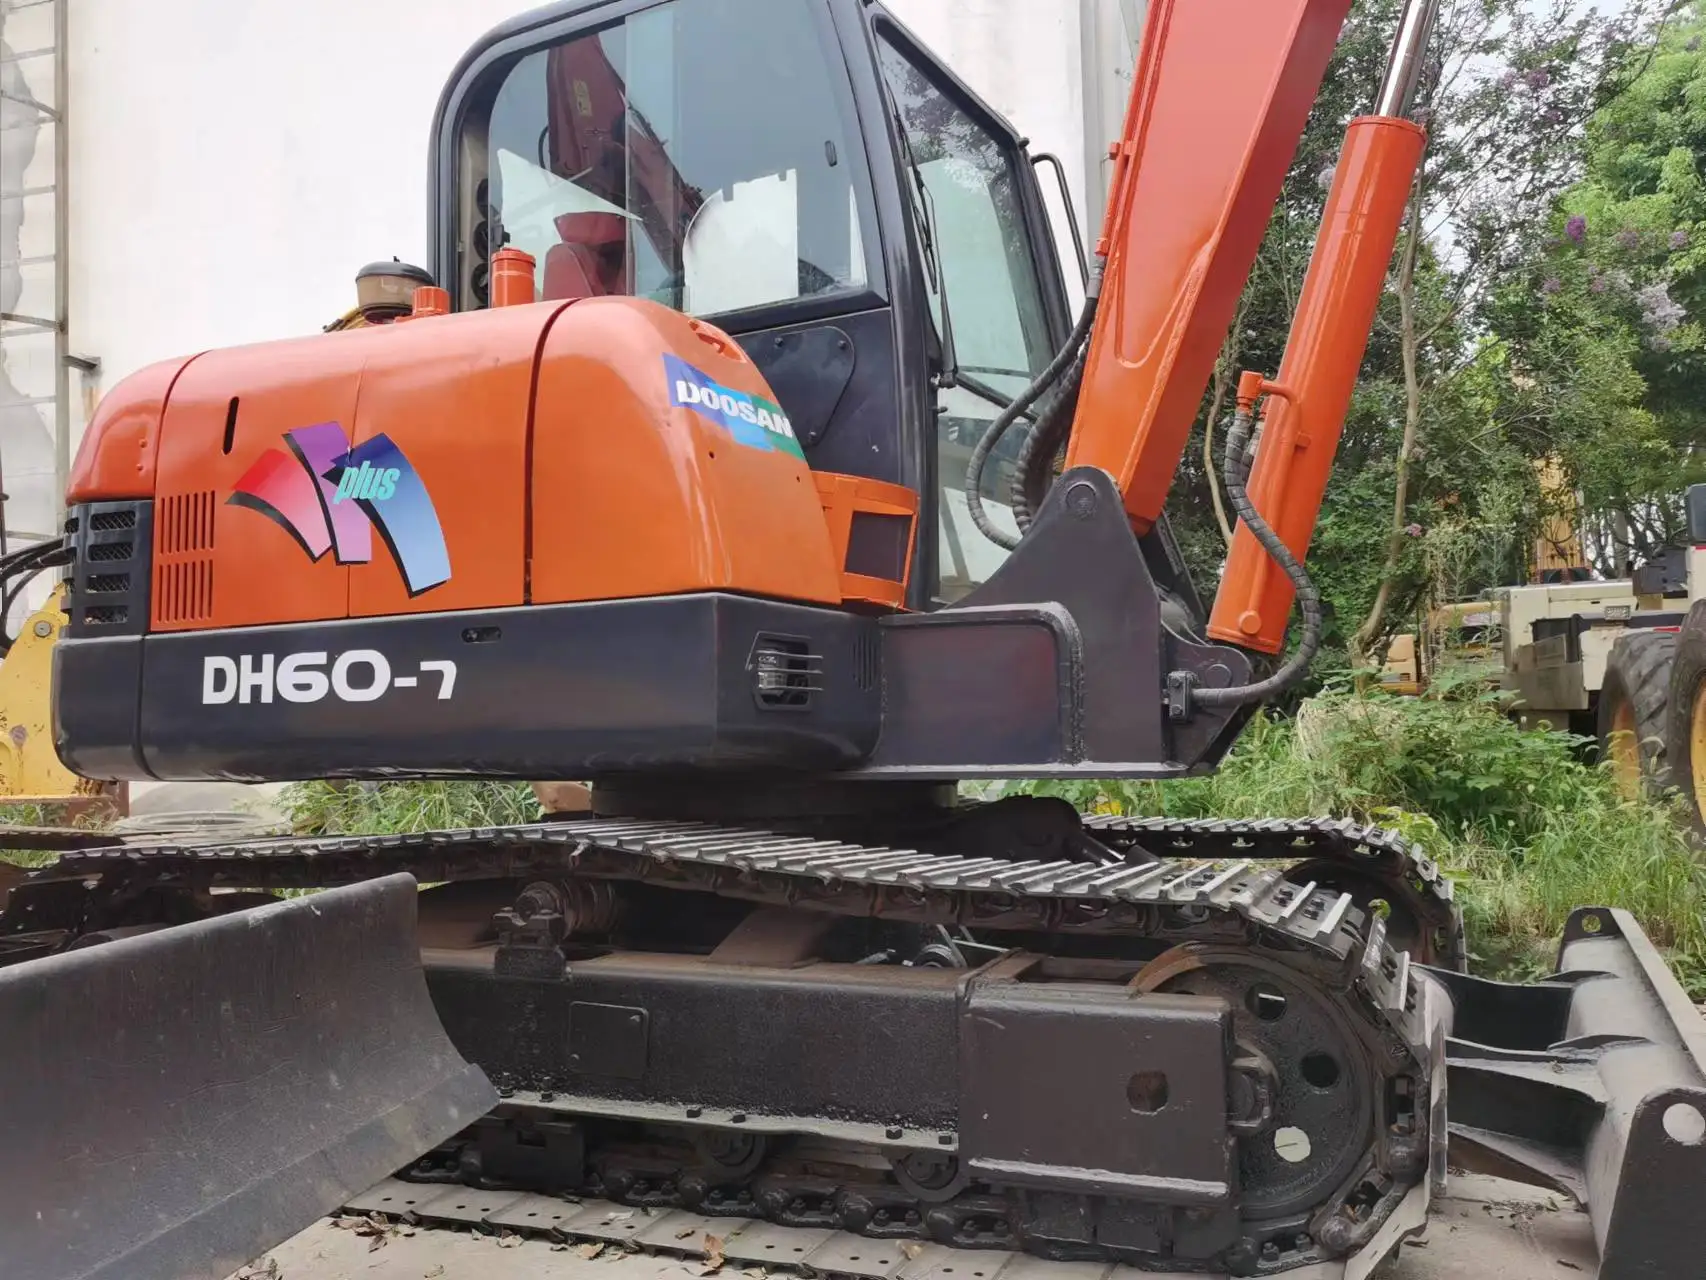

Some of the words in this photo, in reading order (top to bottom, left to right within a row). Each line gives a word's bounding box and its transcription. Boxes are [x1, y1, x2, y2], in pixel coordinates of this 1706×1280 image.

[676, 380, 792, 437] DOOSAN
[333, 460, 401, 504] plus
[203, 650, 458, 704] DH60-7
